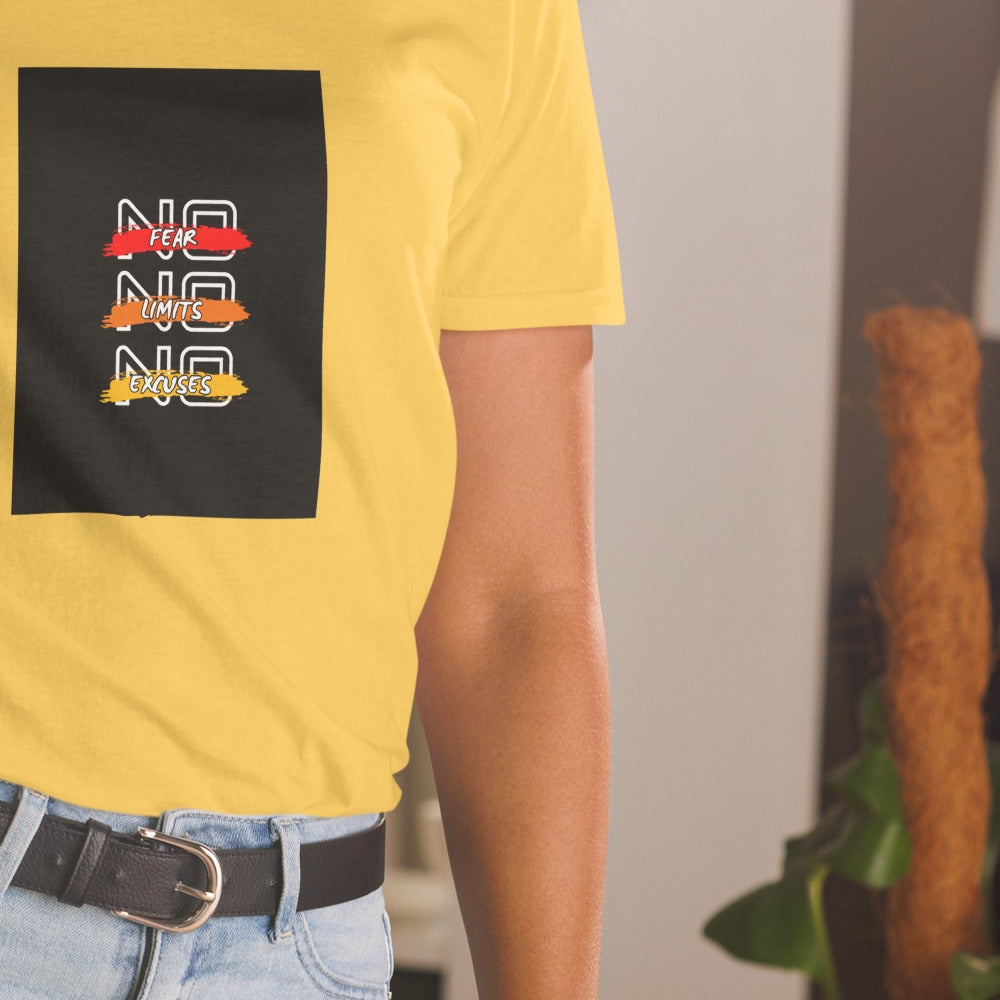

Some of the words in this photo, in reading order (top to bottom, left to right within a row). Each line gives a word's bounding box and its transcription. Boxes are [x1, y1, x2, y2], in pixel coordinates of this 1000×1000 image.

[117, 198, 238, 261] NO
[149, 228, 198, 249] FEAR
[116, 270, 236, 332] NO
[141, 298, 203, 320] LIMITS
[115, 345, 234, 407] NO
[129, 375, 212, 395] EXCUSES
